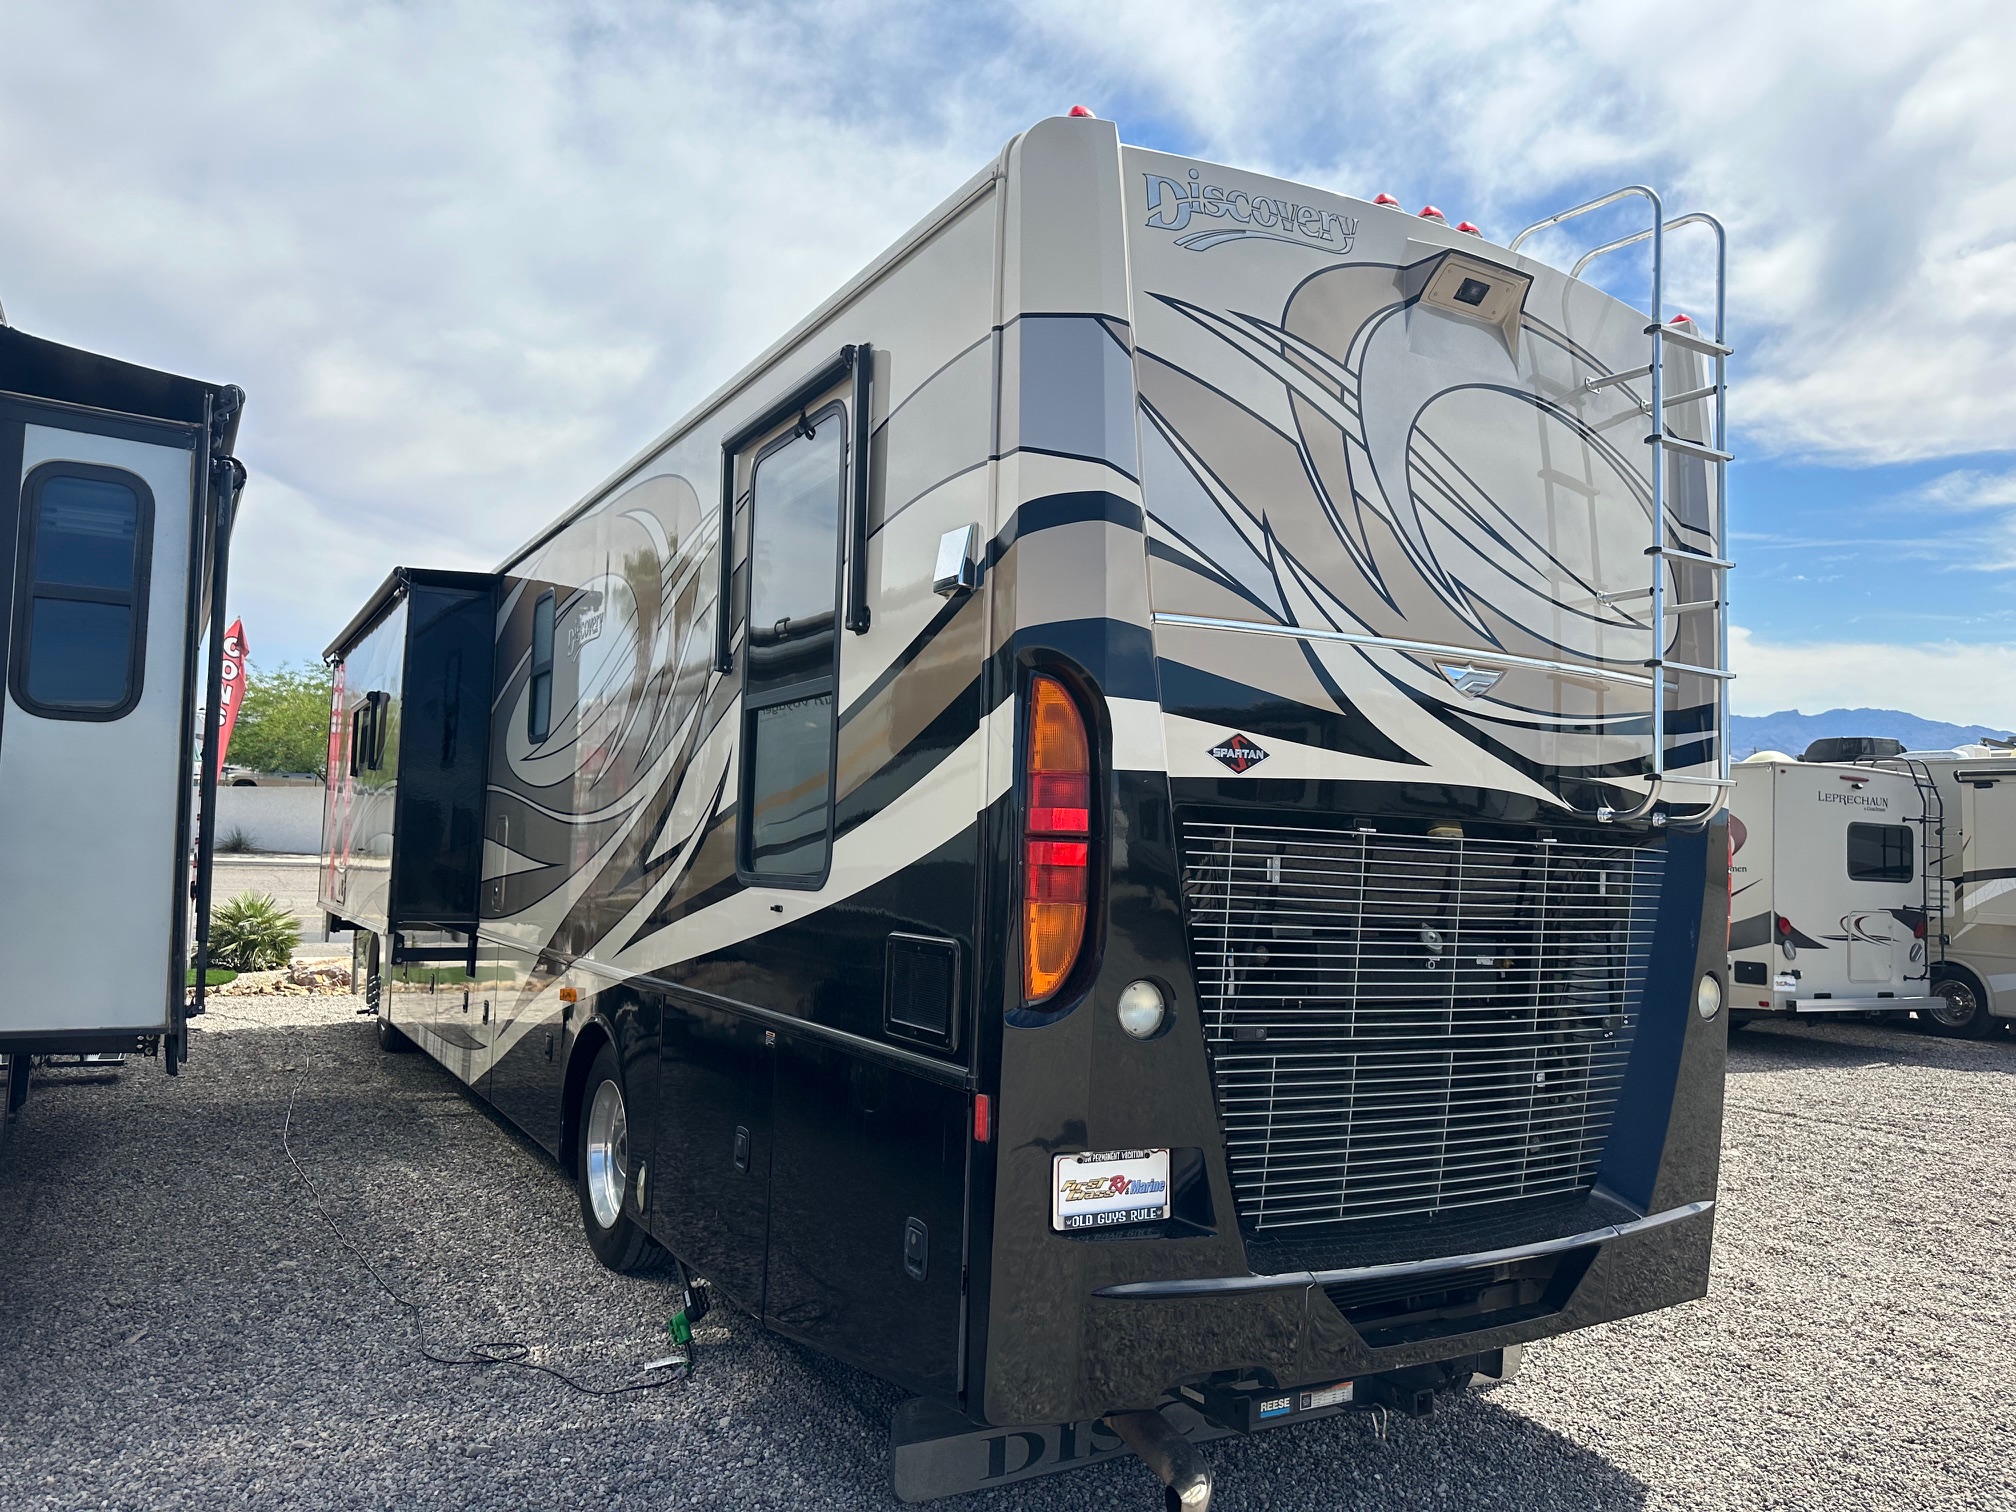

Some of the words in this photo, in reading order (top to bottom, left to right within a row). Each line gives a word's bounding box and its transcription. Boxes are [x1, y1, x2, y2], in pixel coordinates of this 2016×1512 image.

[1142, 168, 1360, 254] Discovery
[1213, 748, 1264, 759] SPARTAN
[1818, 791, 1888, 808] LEPRECHAUN
[1093, 1152, 1120, 1162] PERMANENT
[1122, 1150, 1143, 1160] VACATION
[1065, 1189, 1116, 1202] Class
[1109, 1175, 1132, 1194] RV
[1130, 1178, 1165, 1195] Marine
[1072, 1215, 1092, 1226] OLD
[1098, 1211, 1126, 1224] GUYS
[1131, 1208, 1156, 1220] RULE
[1260, 1397, 1291, 1412] REESE
